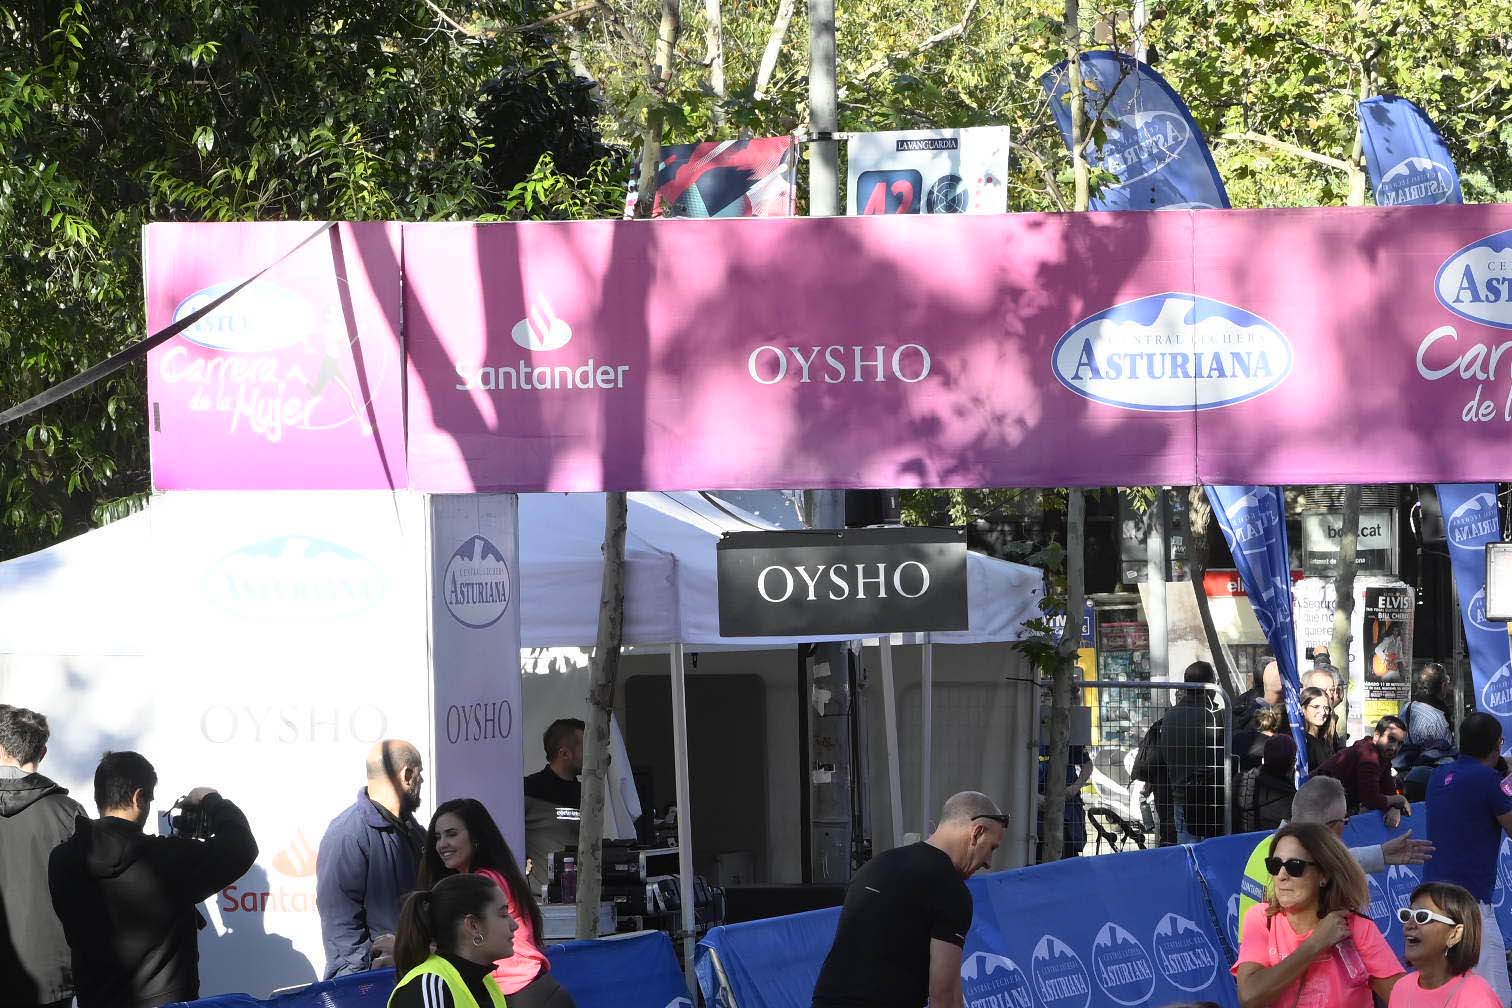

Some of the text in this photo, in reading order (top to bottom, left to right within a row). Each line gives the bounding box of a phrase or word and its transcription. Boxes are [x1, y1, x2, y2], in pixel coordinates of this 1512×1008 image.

[455, 359, 629, 390] Santander
[748, 343, 932, 385] OYSHO
[1071, 338, 1272, 380] ASTURIANA
[1461, 384, 1496, 423] de
[449, 570, 507, 605] ASTURIANA
[757, 560, 930, 603] OYSHO
[1378, 596, 1409, 609] ELVIS
[200, 704, 388, 744] OYSHO
[447, 700, 512, 744] OYSHO
[1037, 971, 1088, 1002] ASTURIANA
[1099, 958, 1152, 988] ASTURIANA
